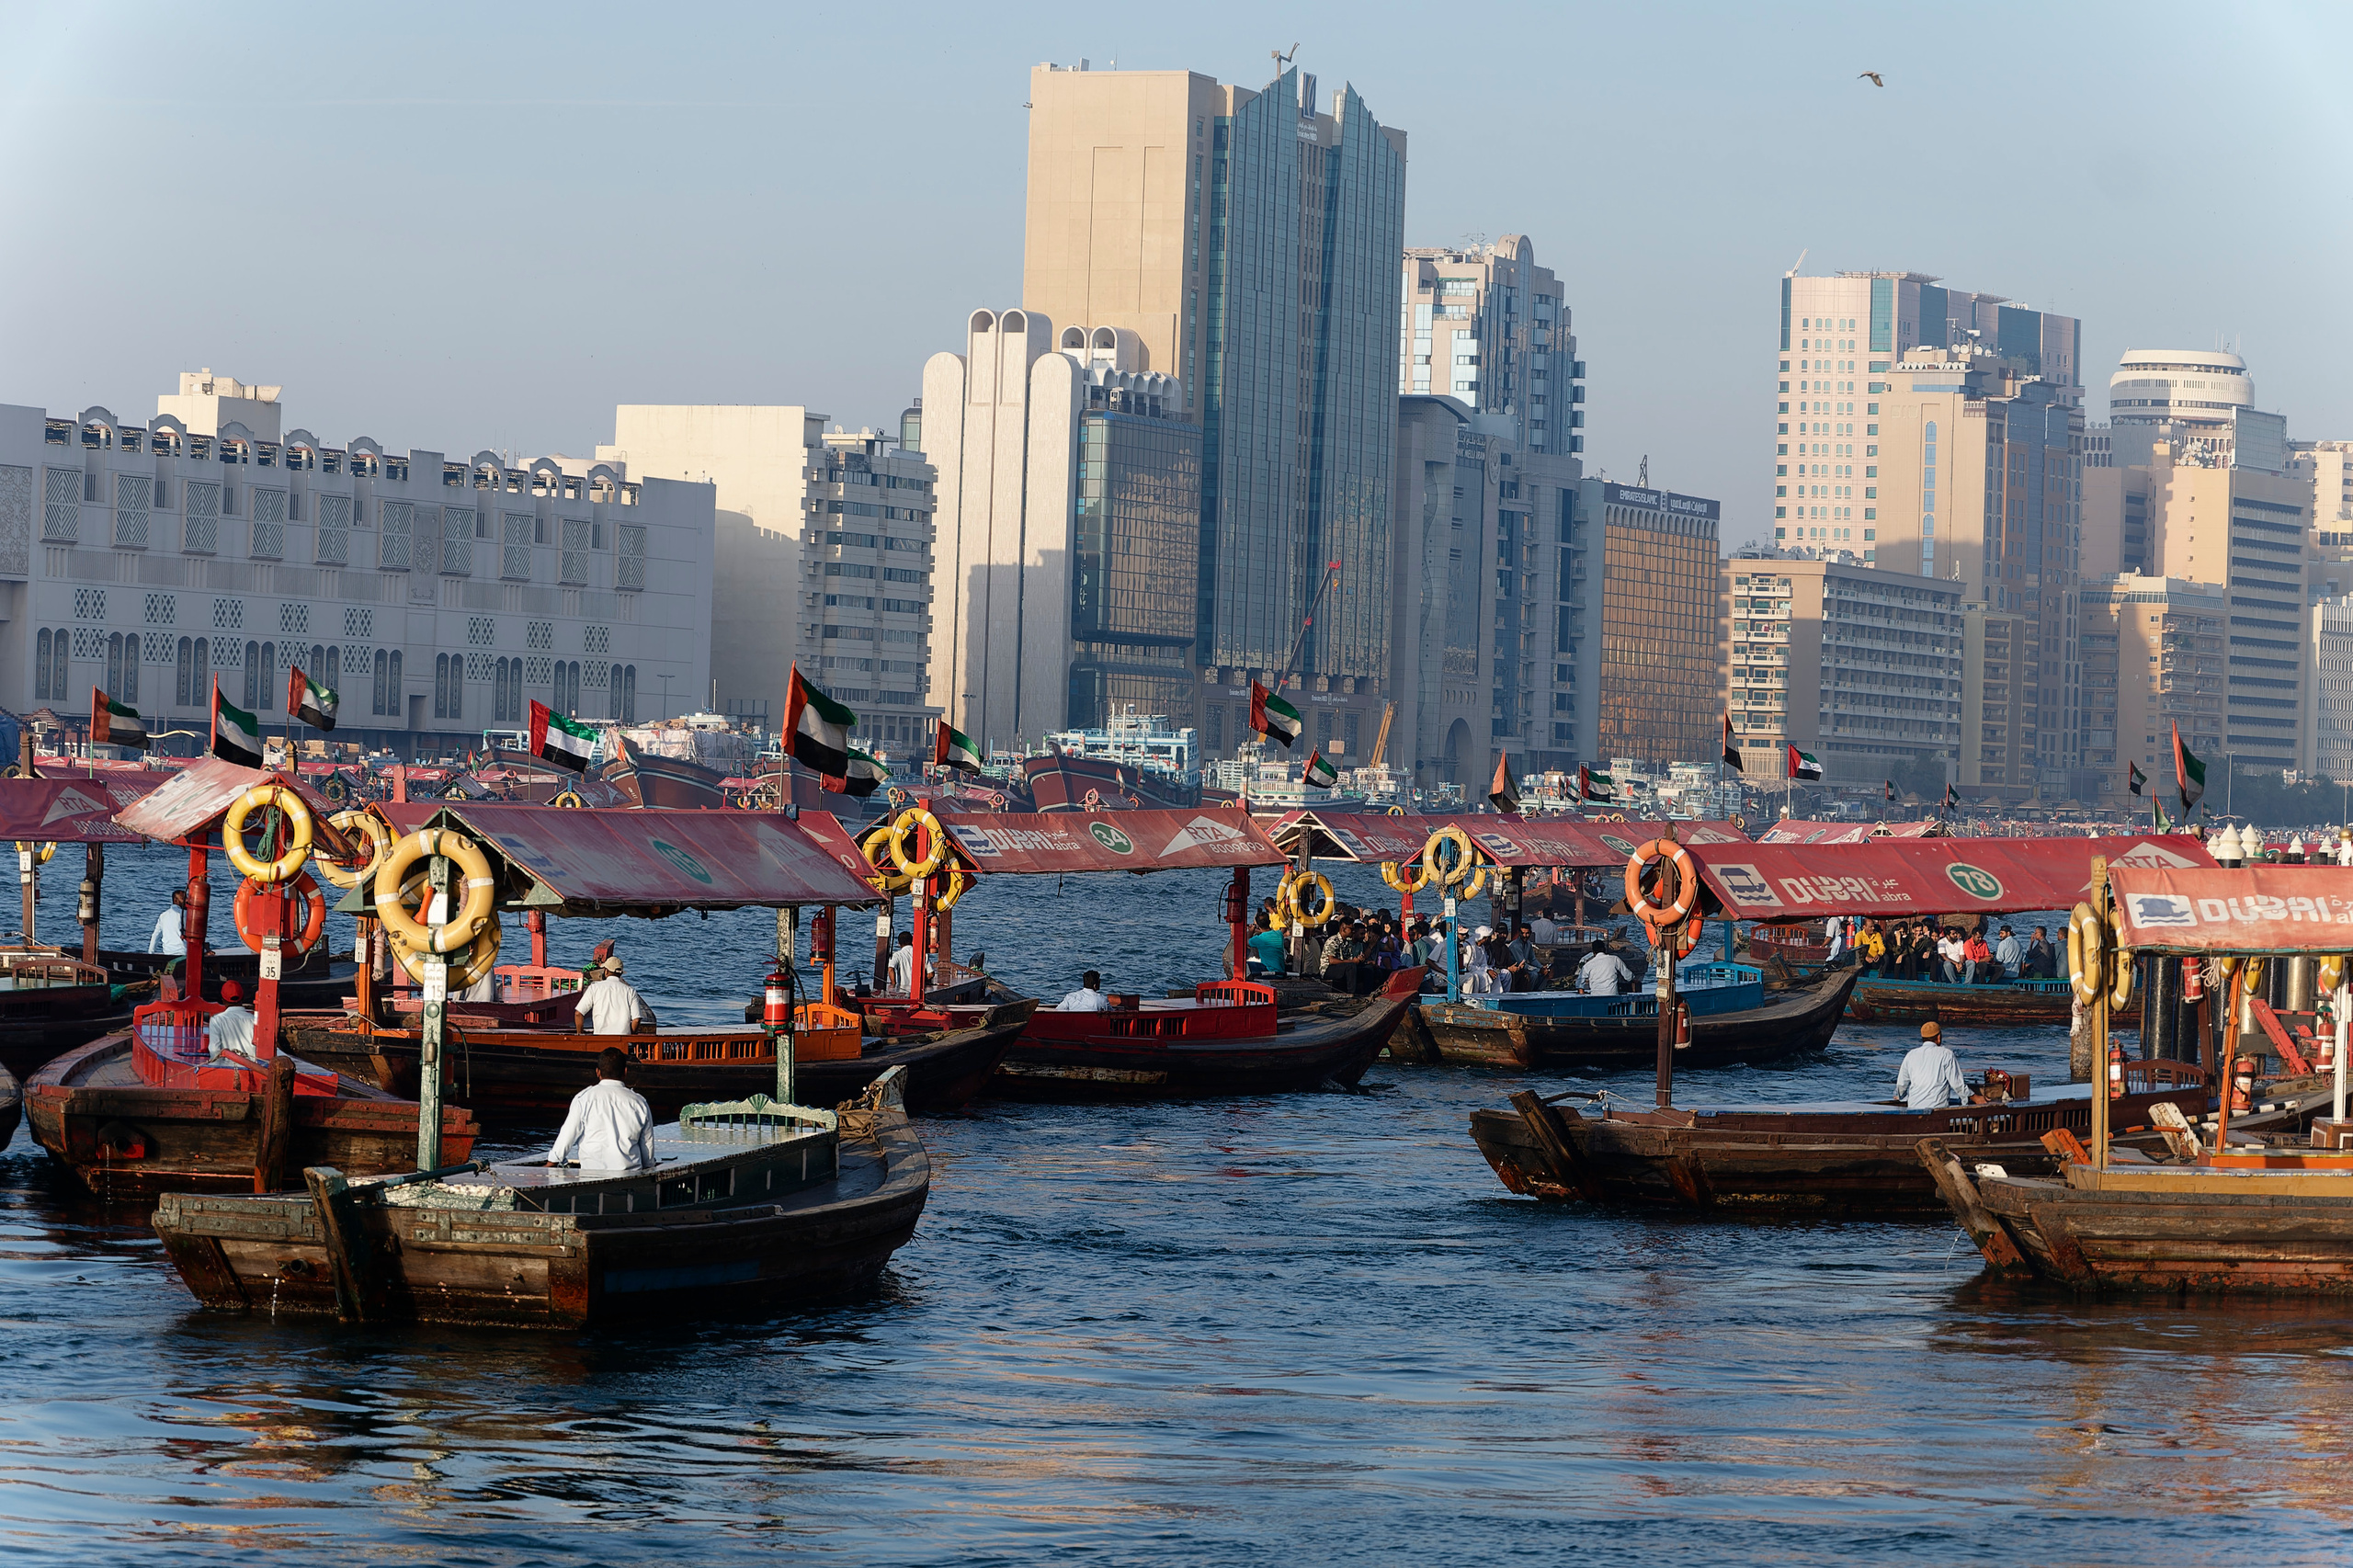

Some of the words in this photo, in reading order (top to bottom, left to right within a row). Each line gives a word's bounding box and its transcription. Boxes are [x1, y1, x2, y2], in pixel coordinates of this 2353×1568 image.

[1620, 489, 1641, 503] EMIRATES
[1641, 493, 1658, 506] ISLAMIC
[58, 797, 95, 812] RTA
[983, 827, 1055, 852] DUBAI
[1043, 829, 1069, 840] عبرة
[1094, 828, 1129, 846] 34
[1186, 826, 1231, 840] RTA
[1054, 840, 1081, 851] abra
[1209, 841, 1266, 854] 8009090
[1607, 839, 1632, 850] 102
[2125, 855, 2174, 869] RTA
[1868, 877, 1899, 890] عبرة
[1952, 869, 1996, 892] 78
[1778, 876, 1881, 904] DUBAI
[1880, 892, 1912, 903] abra
[2198, 894, 2333, 925] DUBAI
[265, 966, 276, 978] 35
